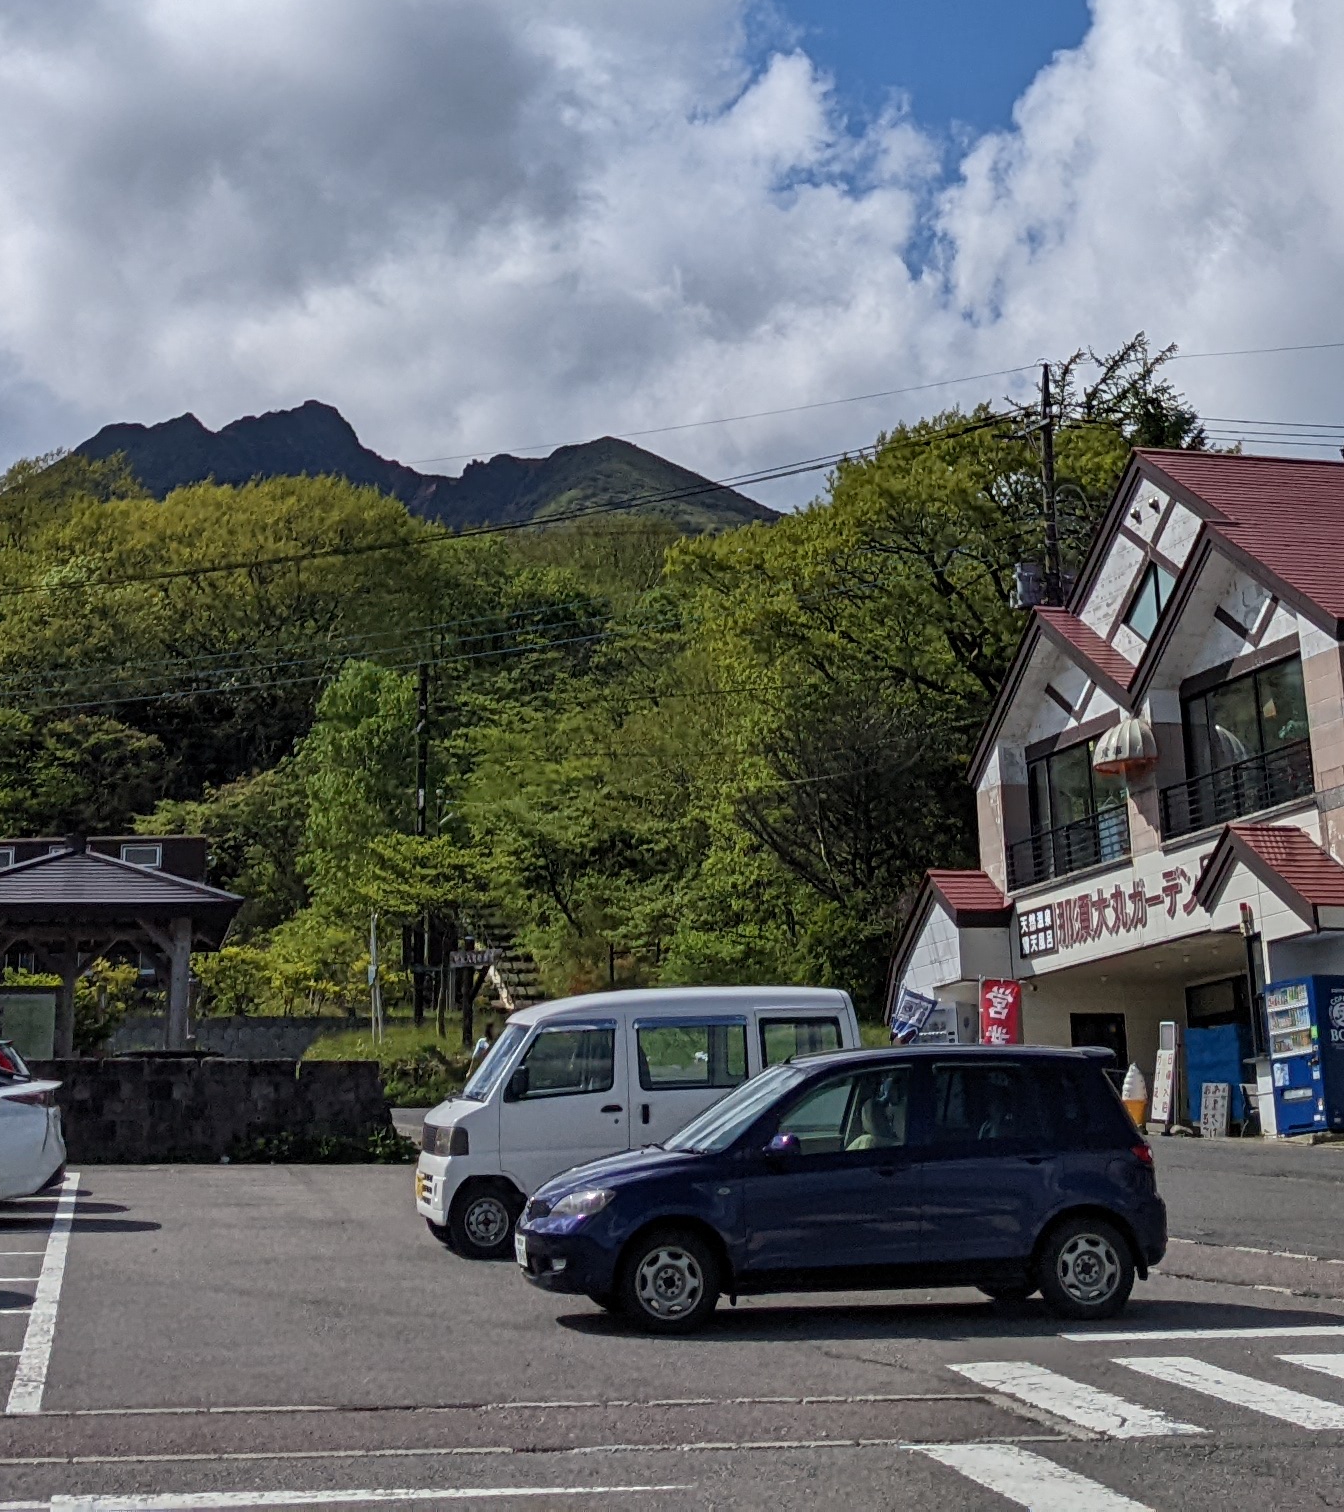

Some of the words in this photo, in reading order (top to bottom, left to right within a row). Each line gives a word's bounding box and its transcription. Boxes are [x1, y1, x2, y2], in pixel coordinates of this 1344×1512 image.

[1019, 908, 1052, 935] 天然温泉
[1057, 852, 1213, 949] 那須大丸ガーデン
